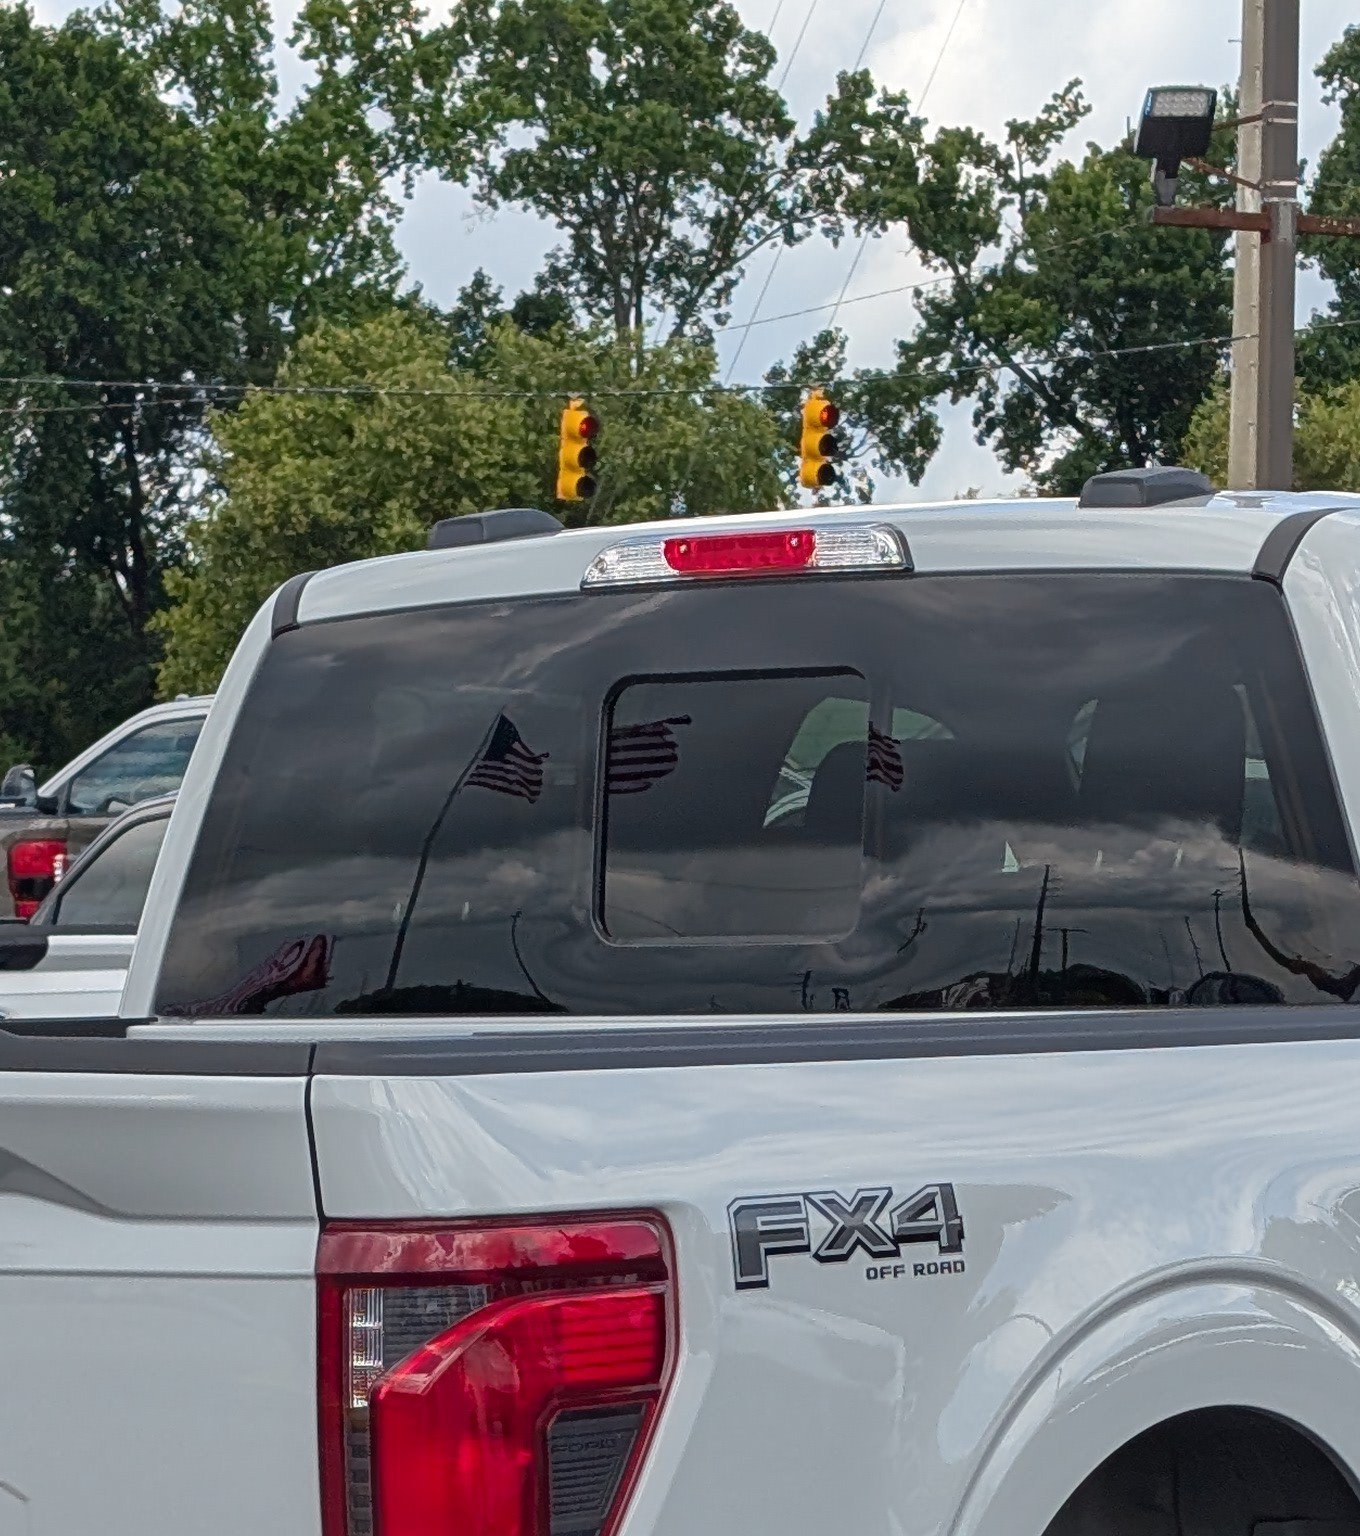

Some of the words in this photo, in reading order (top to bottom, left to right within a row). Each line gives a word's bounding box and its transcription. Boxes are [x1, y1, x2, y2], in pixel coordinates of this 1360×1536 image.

[727, 1182, 966, 1291] FX4
[866, 1264, 905, 1281] OFF
[913, 1260, 966, 1278] ROAD
